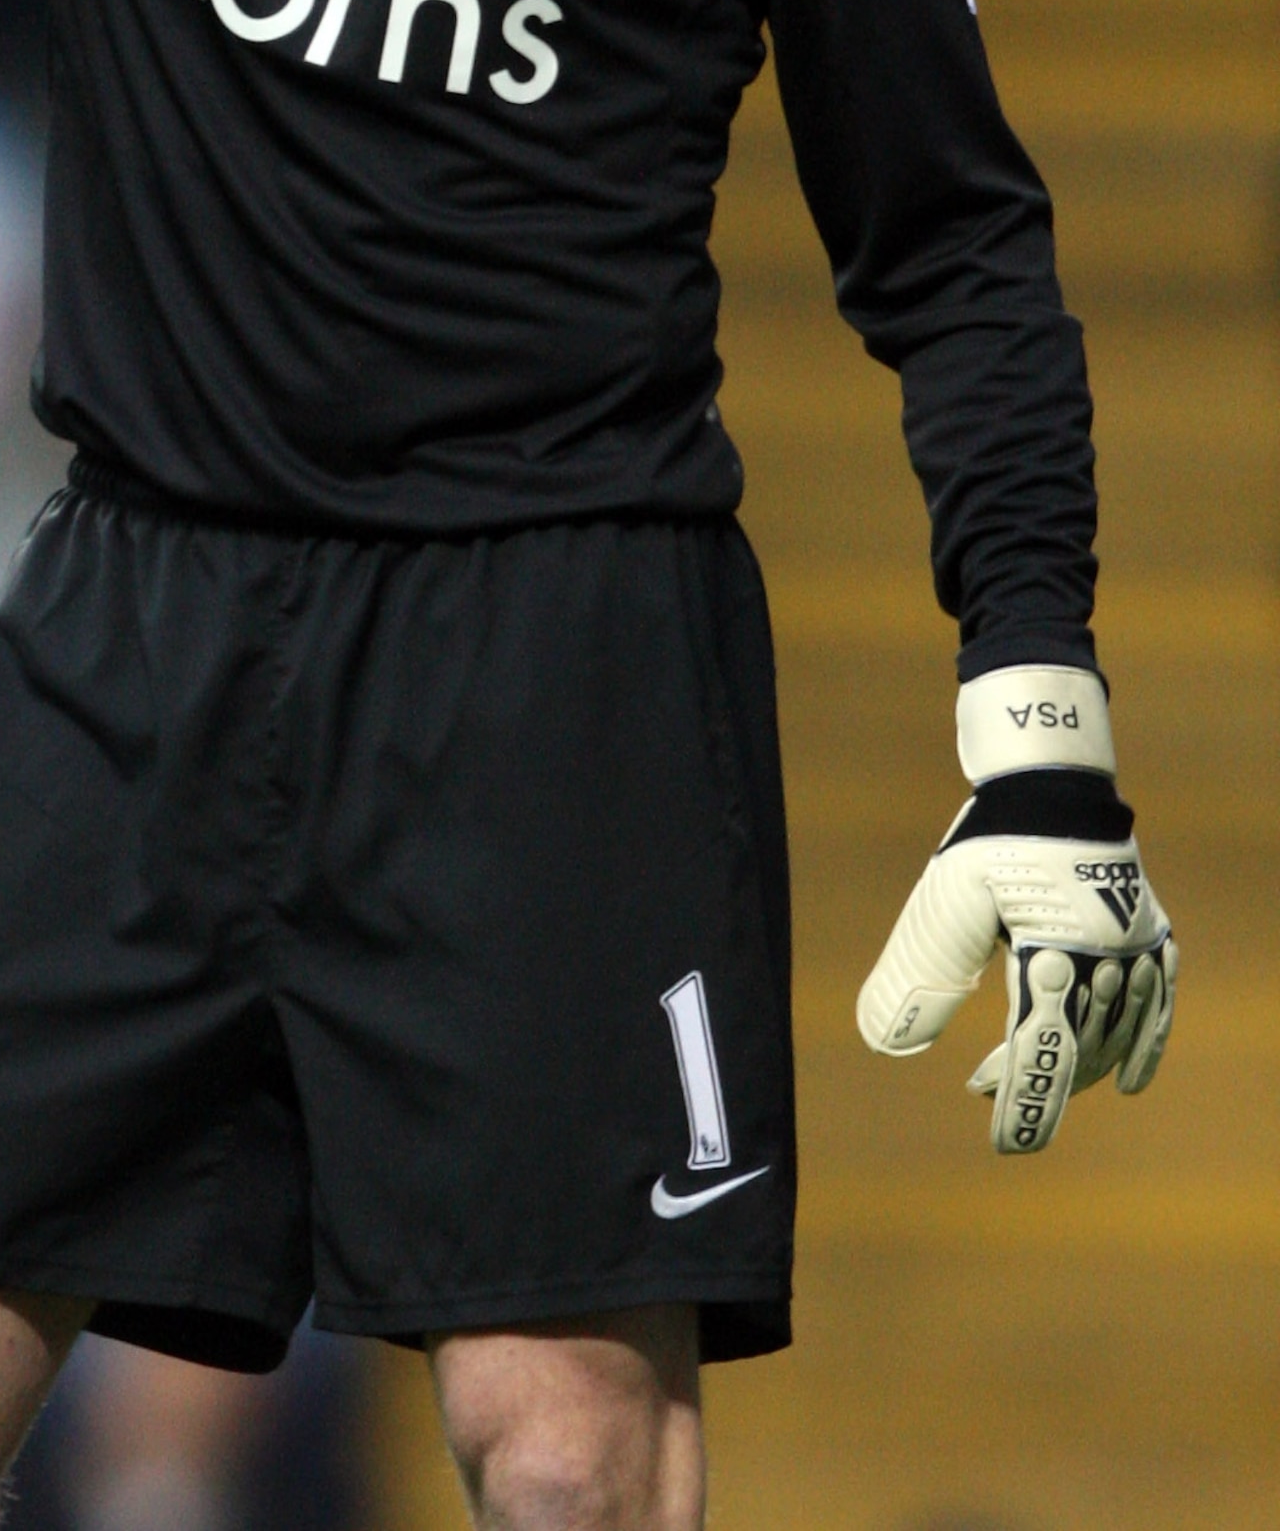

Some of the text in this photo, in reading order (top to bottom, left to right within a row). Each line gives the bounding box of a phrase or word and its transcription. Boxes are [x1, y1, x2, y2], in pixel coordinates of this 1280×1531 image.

[1006, 701, 1080, 730] PSA
[659, 970, 731, 1170] 1
[1014, 1030, 1062, 1147] adidas
